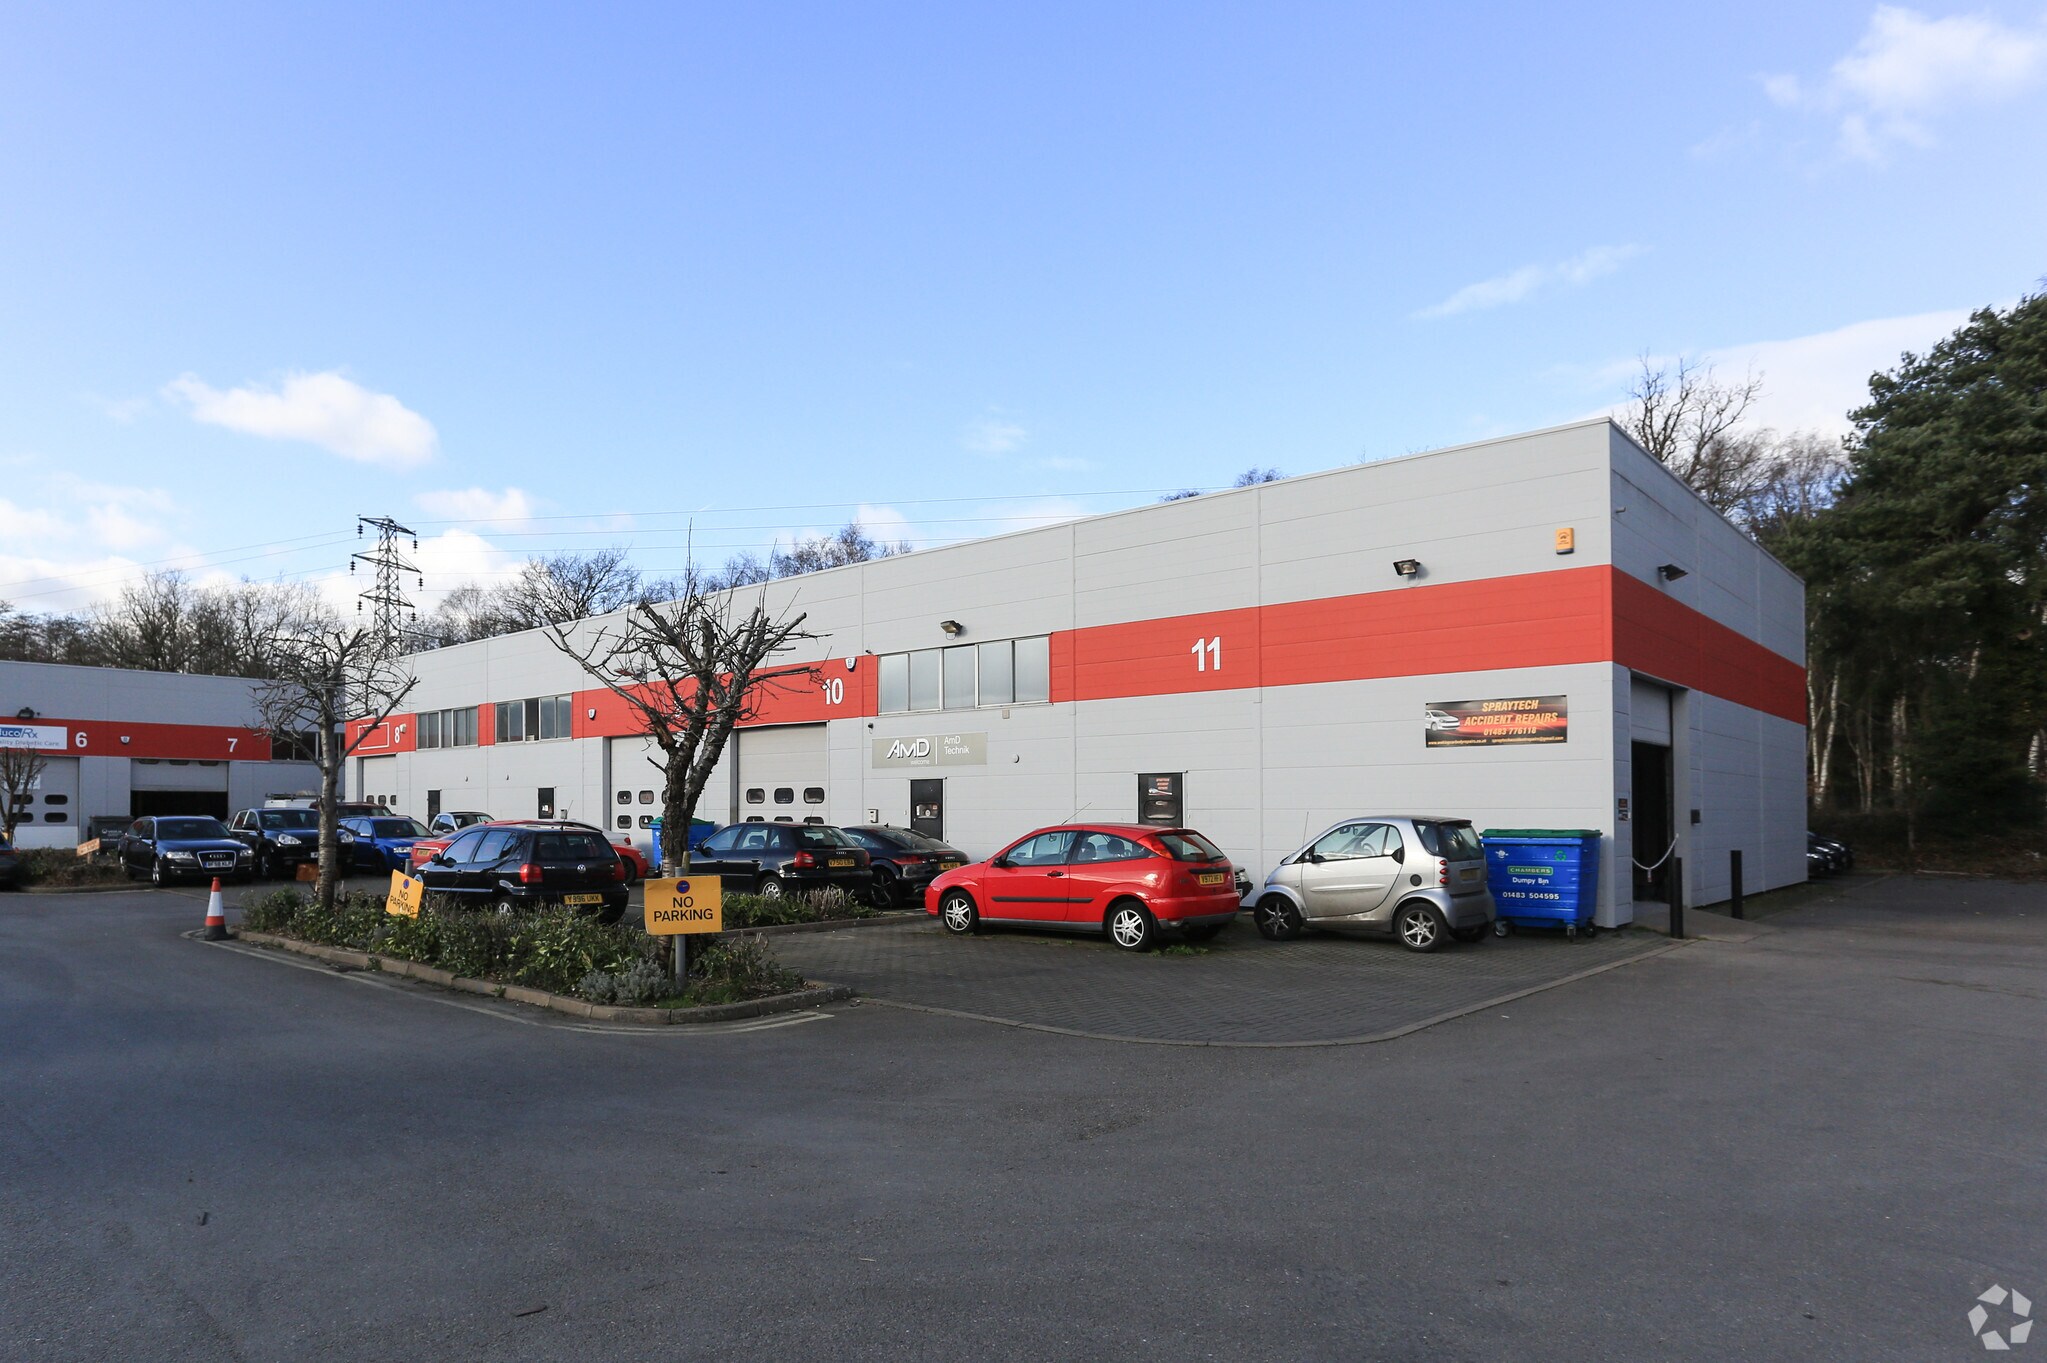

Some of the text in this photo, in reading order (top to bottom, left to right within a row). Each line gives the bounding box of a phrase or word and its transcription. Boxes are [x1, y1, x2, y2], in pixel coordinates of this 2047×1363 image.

[1191, 636, 1220, 671] 11
[822, 677, 843, 704] 10
[1482, 700, 1538, 711] SPRAYTECH
[1464, 712, 1558, 726] ACCIDENT REPAIRS
[394, 726, 400, 743] 8
[1483, 727, 1537, 736] 01483 776118
[75, 731, 88, 748] 6
[227, 738, 238, 752] 7
[944, 746, 970, 755] Technik
[1512, 877, 1536, 885] Dumpy
[399, 890, 409, 901] NO
[673, 896, 694, 908] NO
[389, 895, 415, 914] PARKING
[654, 908, 713, 922] PARKING
